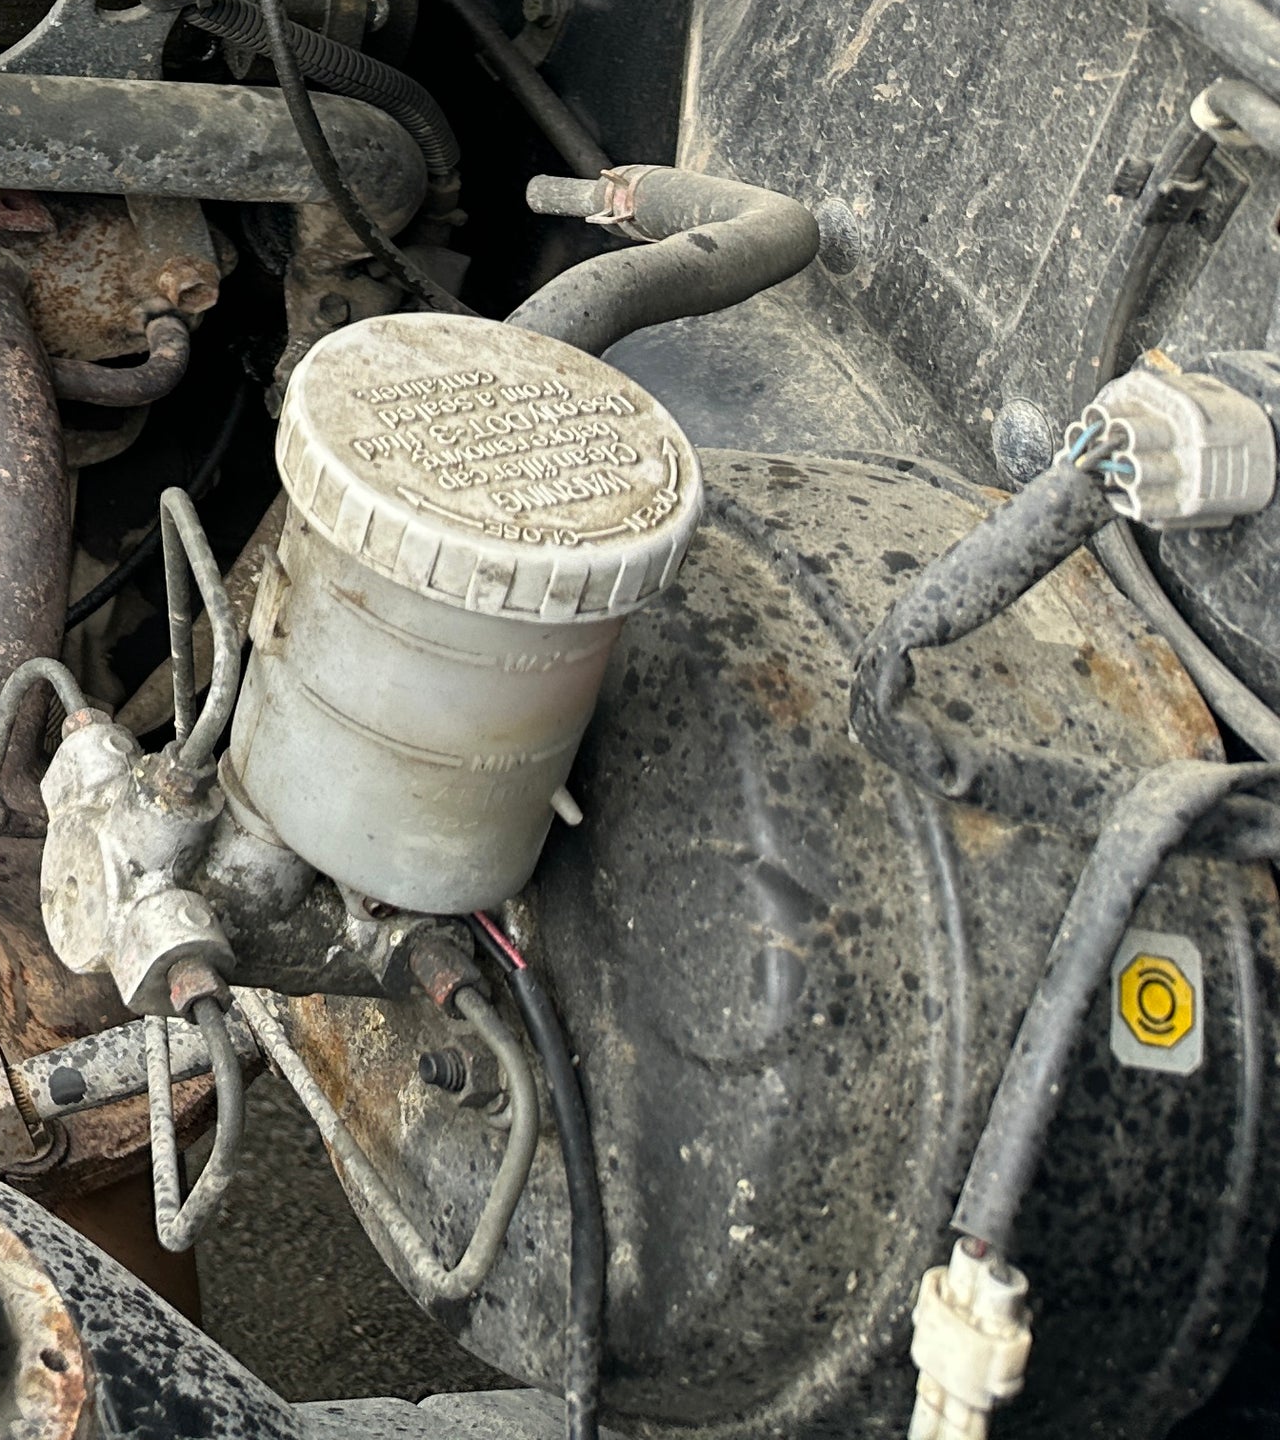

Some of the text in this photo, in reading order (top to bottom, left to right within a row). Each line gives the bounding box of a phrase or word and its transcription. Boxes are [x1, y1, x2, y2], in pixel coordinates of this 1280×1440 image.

[377, 378, 570, 428] from a sealed
[526, 396, 579, 425] only
[578, 392, 636, 417] Use
[352, 429, 424, 461] fluid
[412, 421, 618, 471] before removing
[437, 441, 638, 491] Clean filler cap
[490, 469, 632, 514] WARNING
[622, 488, 679, 531] OPEN
[484, 519, 579, 546] CLOSE
